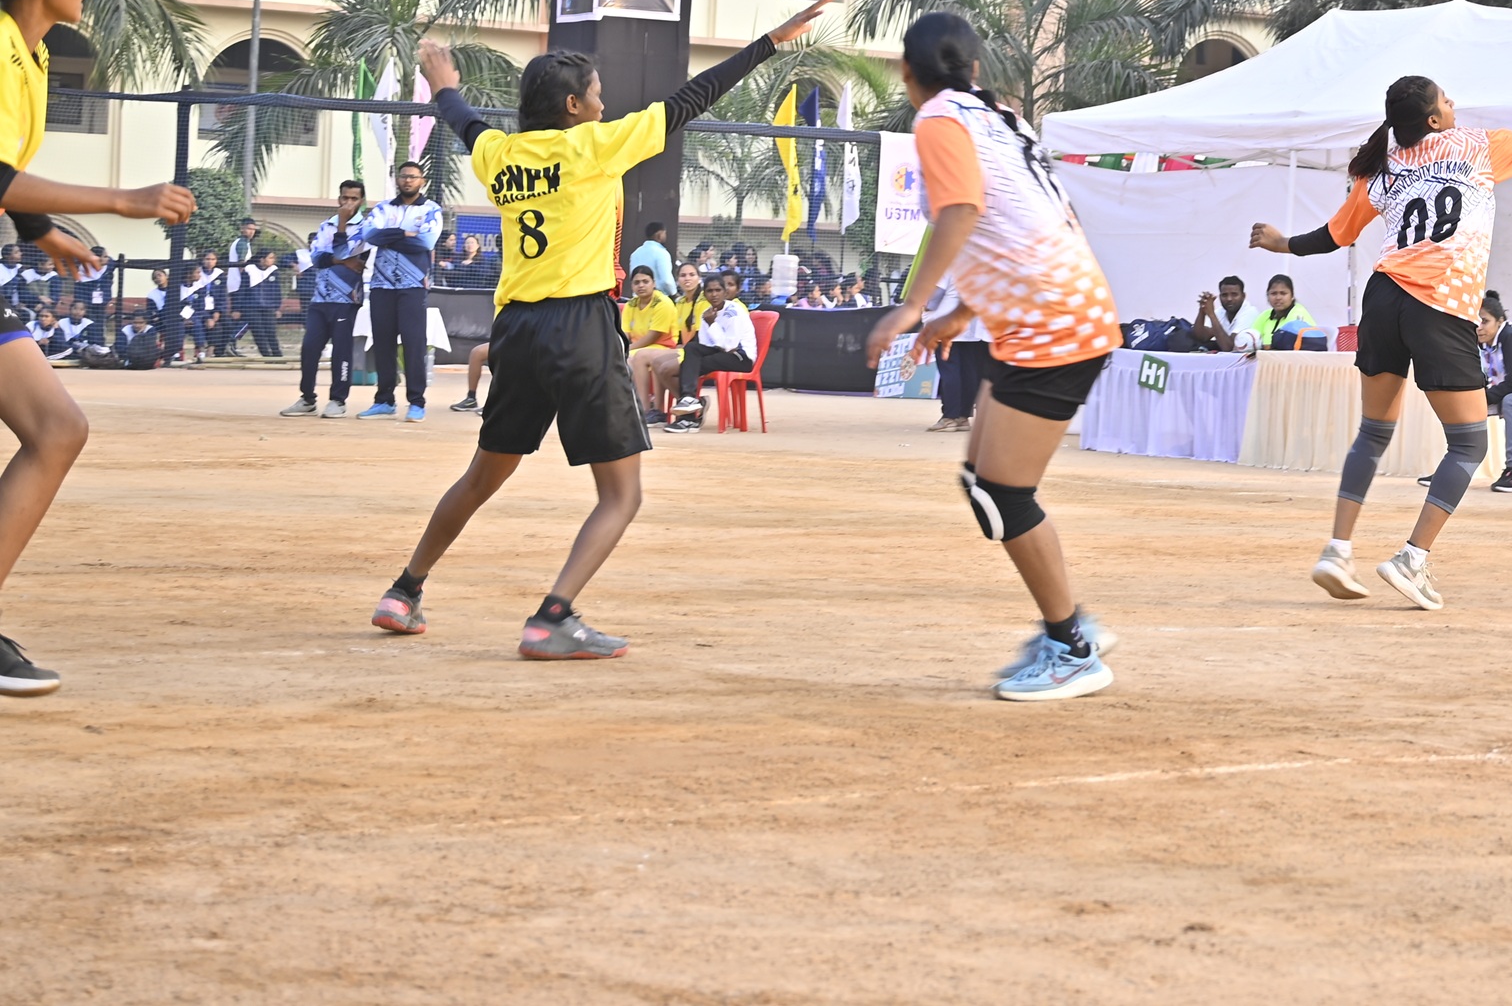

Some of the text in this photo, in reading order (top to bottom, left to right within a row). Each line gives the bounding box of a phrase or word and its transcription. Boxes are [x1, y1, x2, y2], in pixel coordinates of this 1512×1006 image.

[1387, 160, 1473, 201] UNIVERSITY OF KAANI
[517, 209, 548, 260] 8
[885, 206, 922, 222] USTM
[1397, 185, 1462, 250] 08
[1140, 360, 1166, 389] H1
